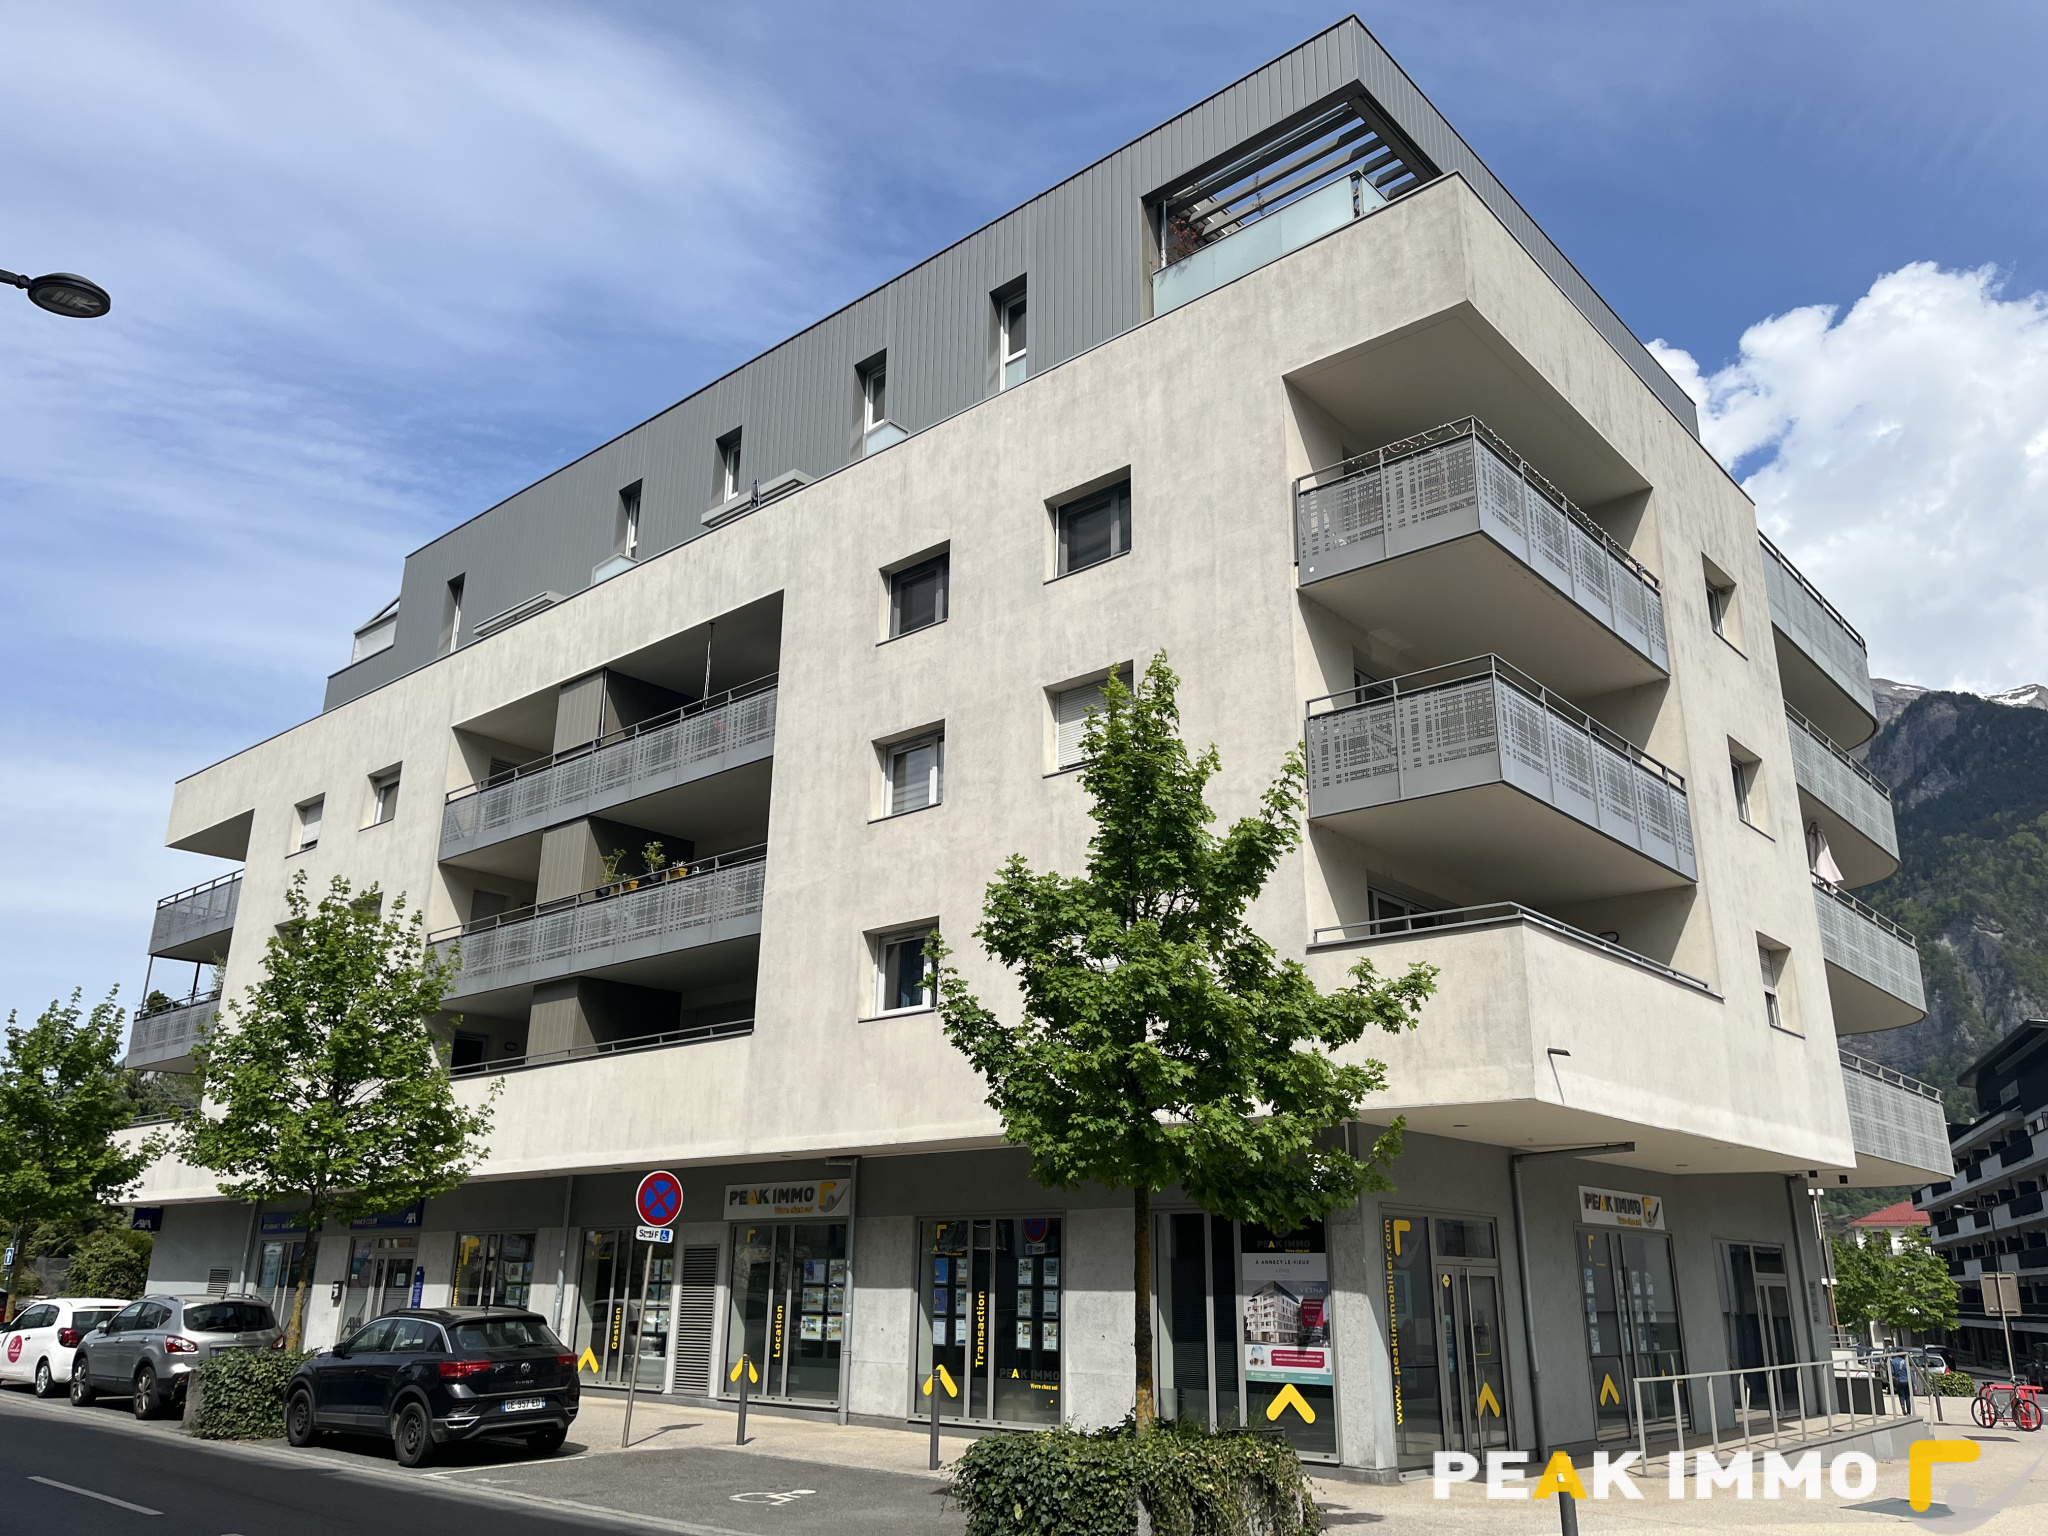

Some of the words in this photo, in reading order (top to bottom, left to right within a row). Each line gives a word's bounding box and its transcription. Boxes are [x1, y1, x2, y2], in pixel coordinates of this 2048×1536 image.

[729, 1189, 770, 1206] PEAK
[772, 1187, 815, 1204] IMMO
[1584, 1192, 1613, 1212] PEAK
[1613, 1196, 1642, 1215] IMMO
[132, 1218, 151, 1229] AXA
[1257, 1240, 1282, 1249] PEAK
[1284, 1240, 1311, 1248] IMMO
[1299, 1286, 1324, 1294] VESNA
[611, 1307, 621, 1349] Gestion
[773, 1305, 783, 1357] Location
[975, 1290, 985, 1367] Transaction
[999, 1367, 1028, 1379] PEAK
[1030, 1369, 1060, 1381] IMMO
